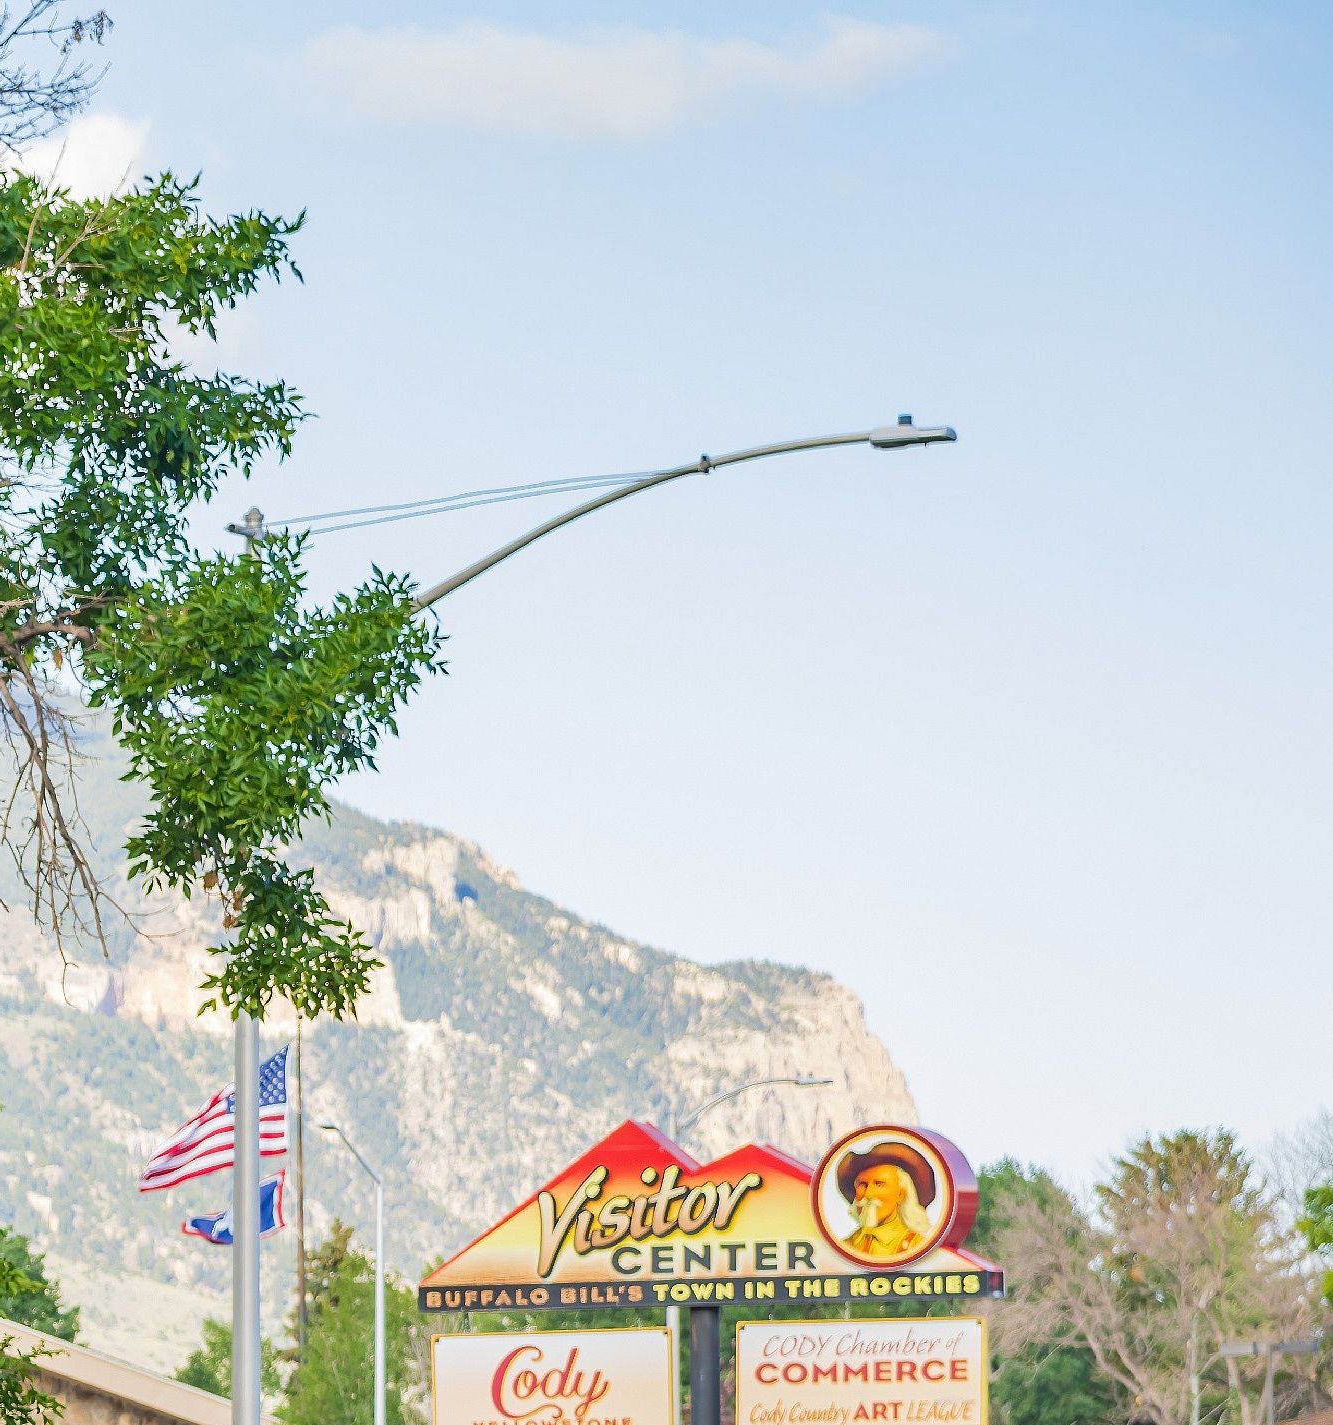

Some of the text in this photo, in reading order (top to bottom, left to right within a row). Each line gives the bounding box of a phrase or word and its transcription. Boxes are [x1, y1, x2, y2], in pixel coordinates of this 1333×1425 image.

[537, 1164, 763, 1279] Visitor
[611, 1240, 817, 1275] CENTER
[426, 1274, 981, 1308] BUFFALO BILL'S TOWN IN THE ROCKIES
[763, 1327, 965, 1358] CODY Chamber of
[491, 1345, 611, 1419] Cody
[754, 1359, 969, 1385] COMMERCE
[853, 1401, 904, 1421] ART
[907, 1399, 977, 1423] LEAGUE
